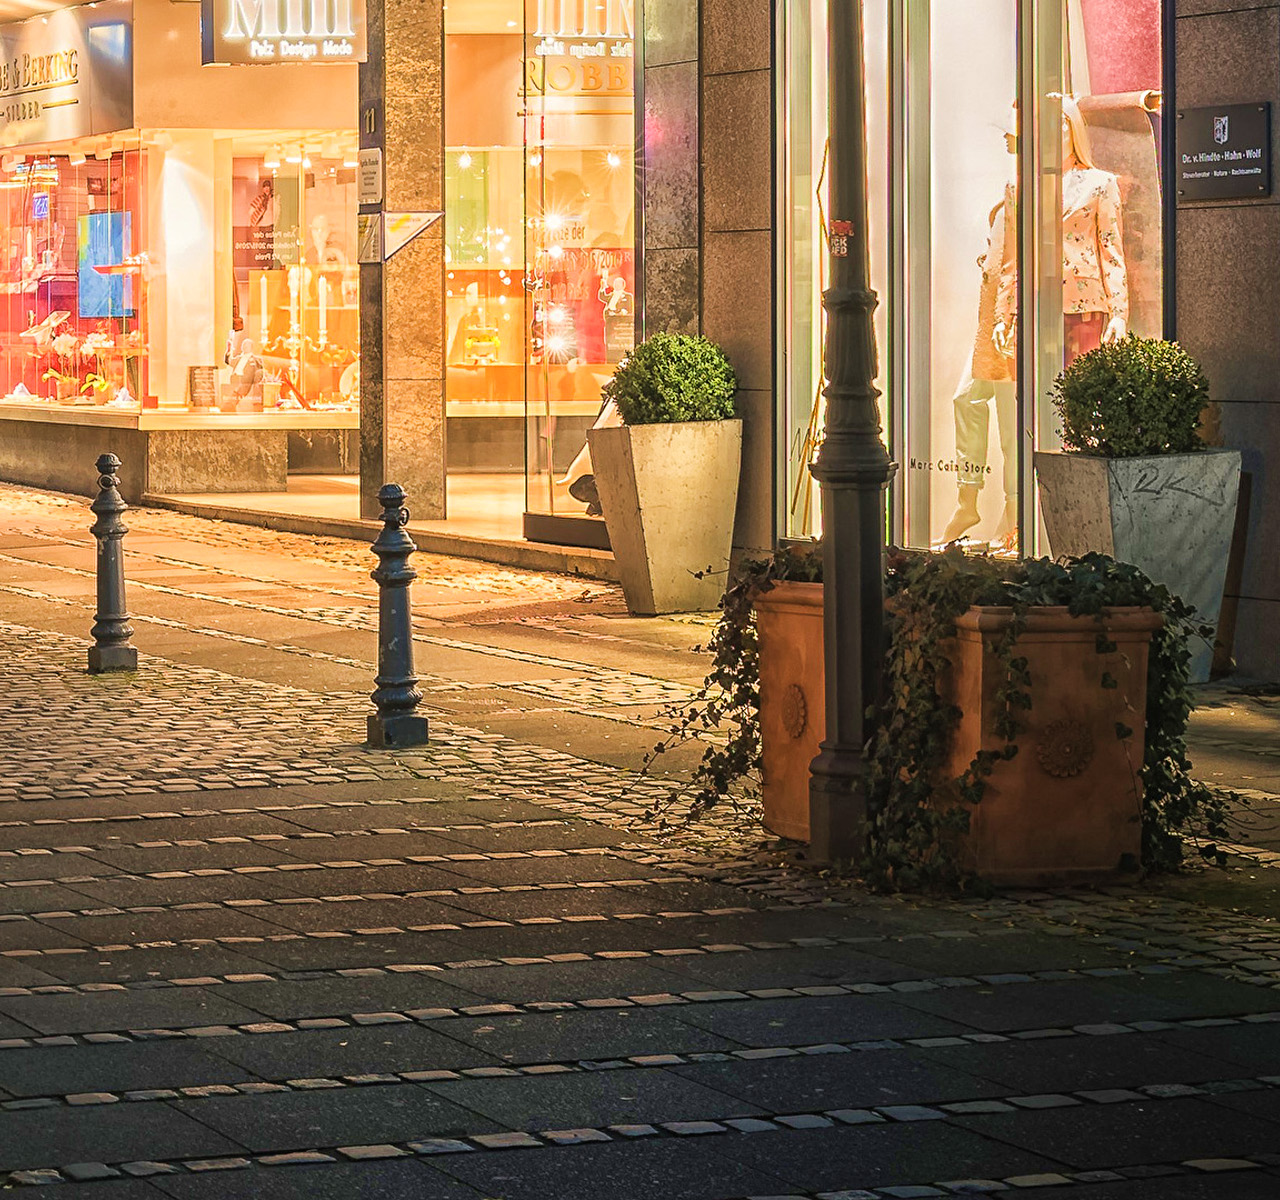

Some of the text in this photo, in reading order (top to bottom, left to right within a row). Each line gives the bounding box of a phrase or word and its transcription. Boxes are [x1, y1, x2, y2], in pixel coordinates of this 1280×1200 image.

[280, 40, 317, 59] Design
[323, 39, 352, 57] Mode
[11, 58, 20, 89] &
[519, 57, 634, 92] ROBB
[909, 457, 992, 475] Marc Cain Store
